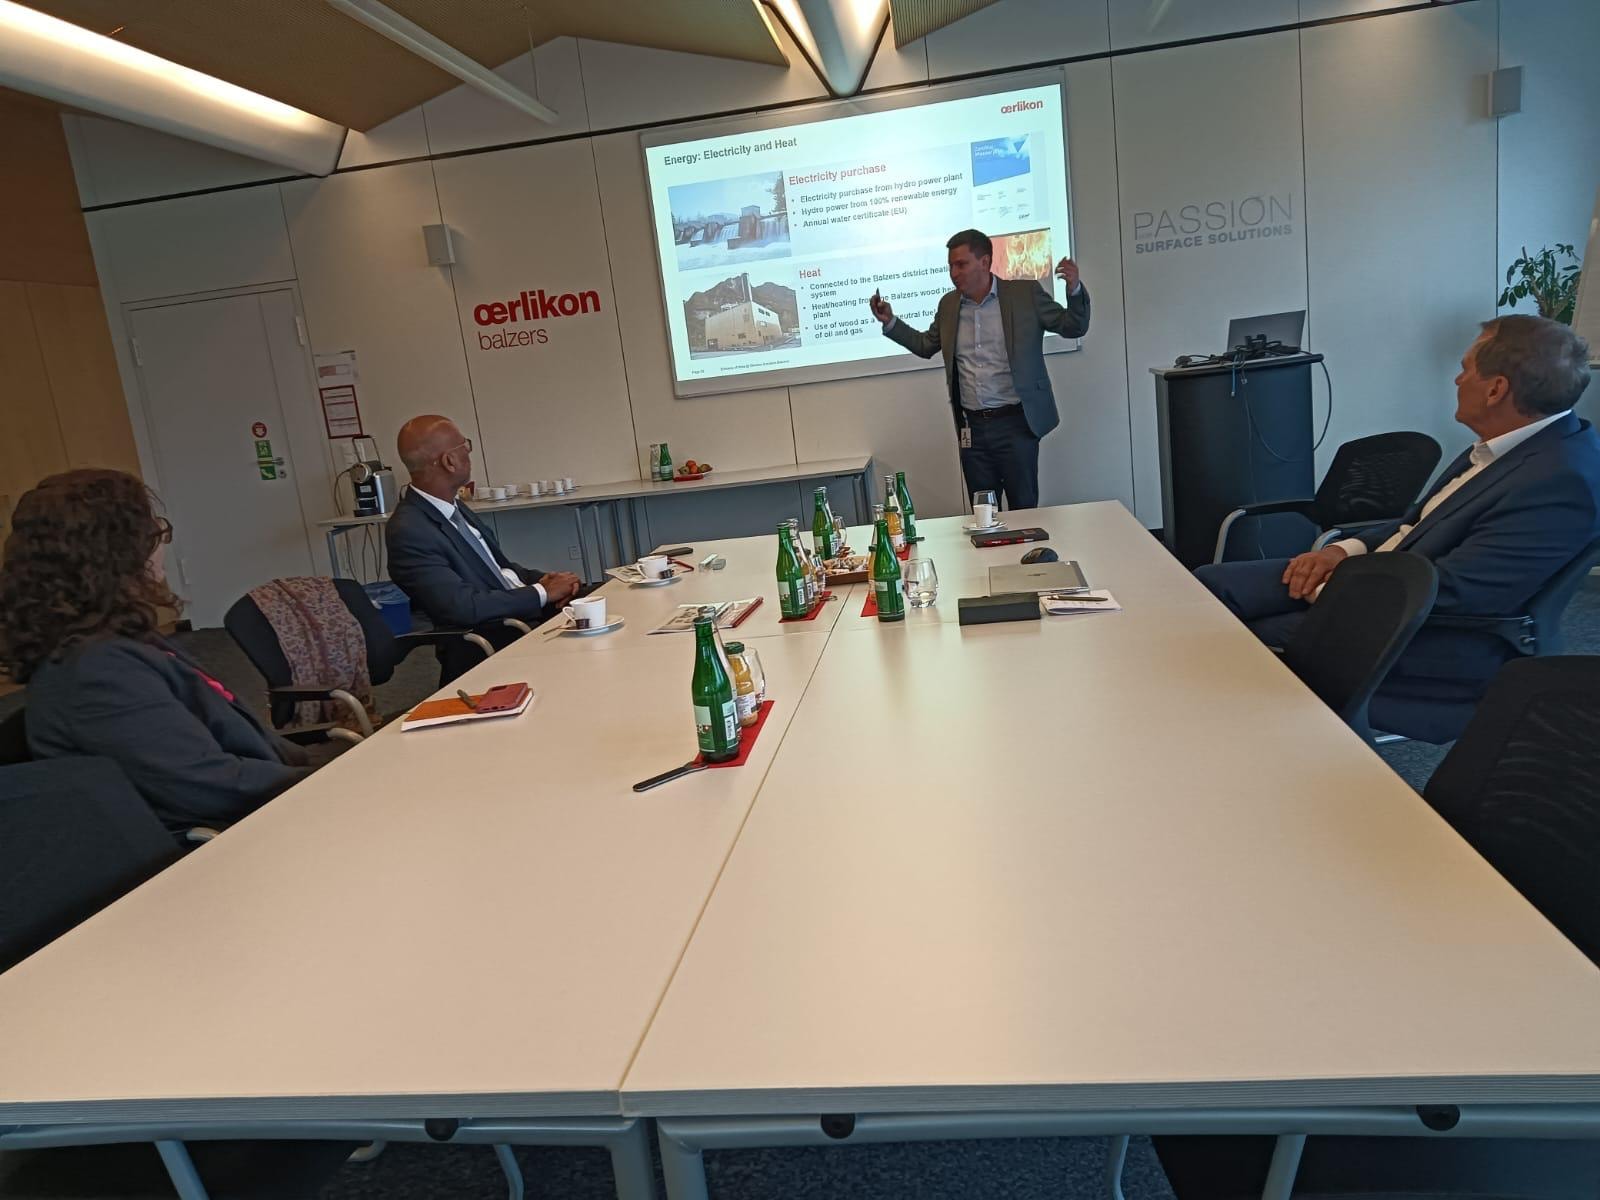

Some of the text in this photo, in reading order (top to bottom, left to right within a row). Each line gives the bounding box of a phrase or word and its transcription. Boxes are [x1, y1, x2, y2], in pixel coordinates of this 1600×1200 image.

[664, 138, 797, 166] Energy: Electricity and Heat
[789, 163, 886, 186] Electricity purchase
[800, 172, 963, 203] Electricity purchase from hydro power plant
[801, 205, 824, 216] Hydro
[825, 202, 848, 214] power
[850, 199, 867, 208] from
[891, 190, 929, 203] renewable
[931, 186, 957, 198] energy
[802, 206, 908, 227] Annual water certificate (EU)
[1133, 192, 1293, 240] PASSION
[1135, 224, 1293, 254] SURFACE SOLUTIONS
[799, 268, 821, 279] Heat
[810, 278, 849, 290] Connected
[850, 277, 858, 285] to
[860, 275, 871, 284] the
[873, 272, 900, 282] Balzers
[902, 268, 928, 278] district
[811, 289, 837, 299] system
[812, 298, 857, 311] Heat/heating
[858, 295, 871, 304] fro
[891, 289, 918, 300] Balzers
[920, 287, 940, 297] wood
[813, 311, 831, 321] plant
[814, 323, 828, 331] Use
[830, 320, 838, 329] of
[838, 318, 858, 328] wood
[897, 310, 920, 320] eutral
[478, 328, 549, 351] balzers
[815, 327, 863, 339] of oil and gas
